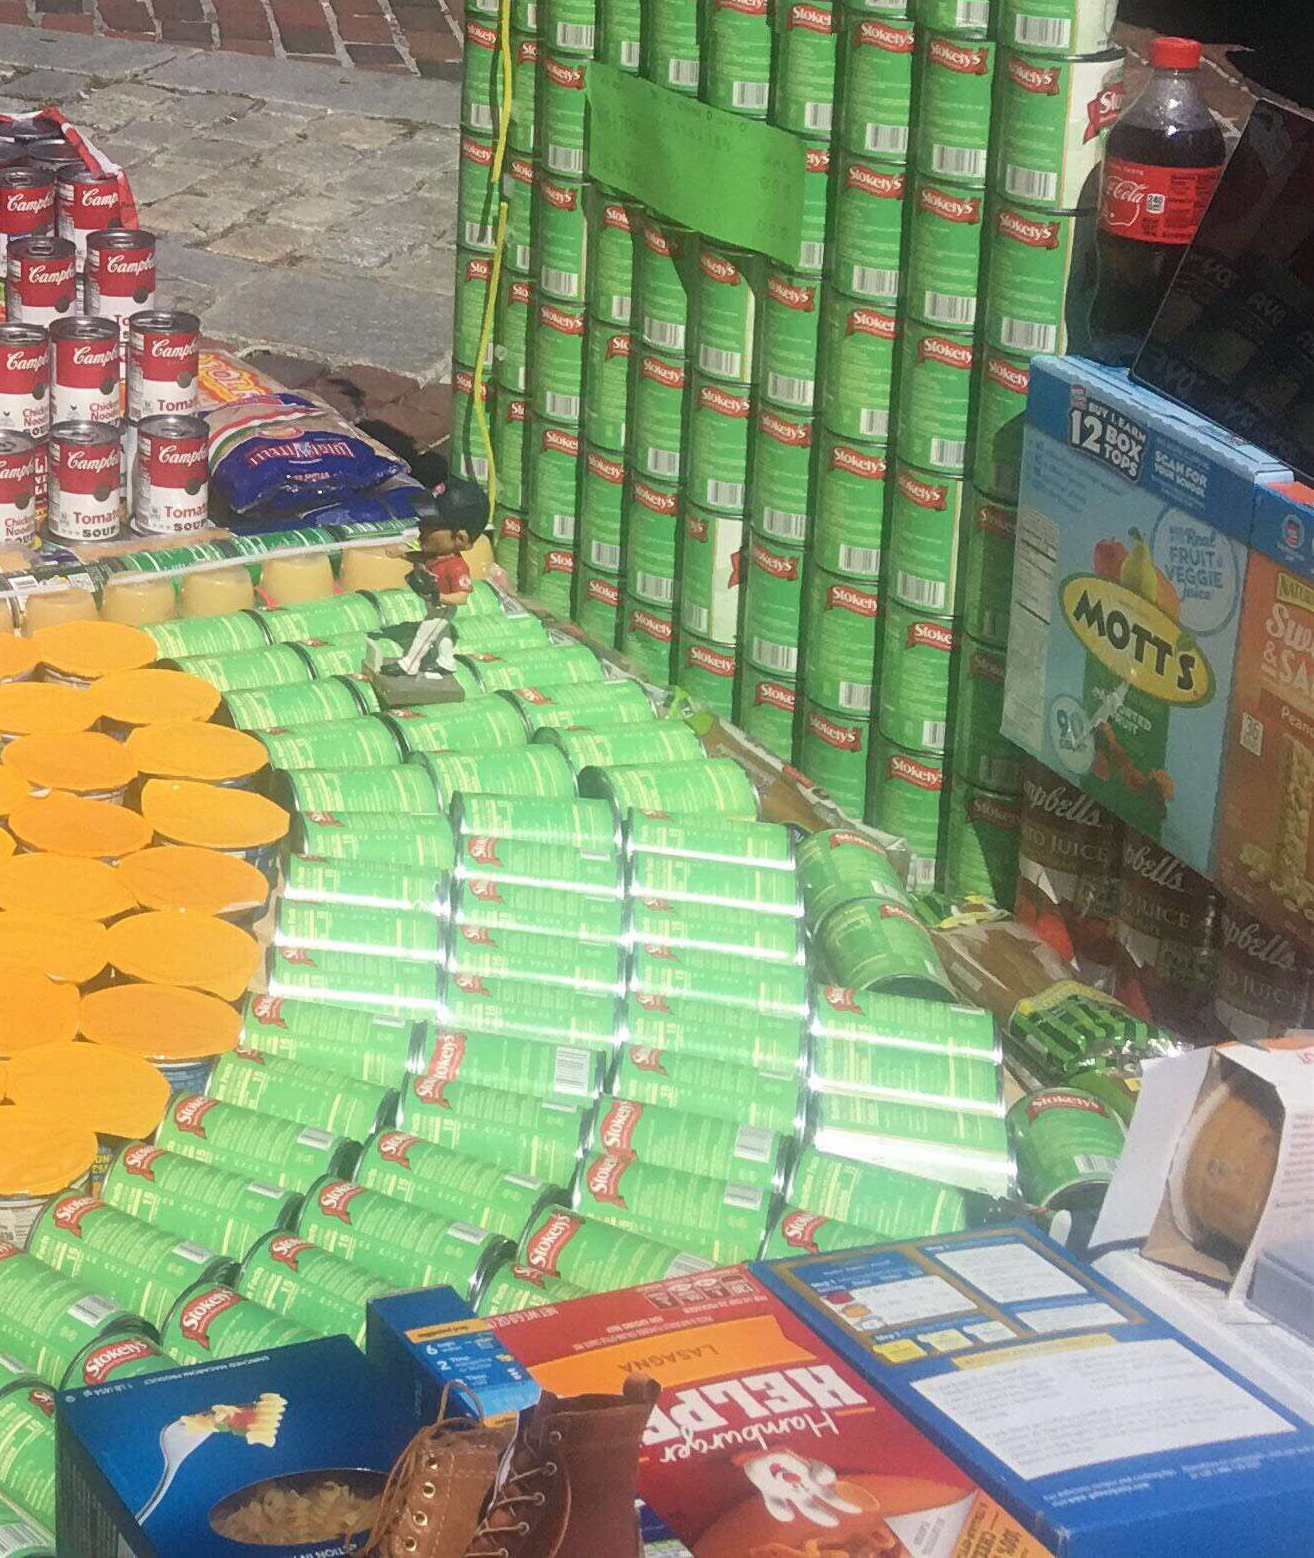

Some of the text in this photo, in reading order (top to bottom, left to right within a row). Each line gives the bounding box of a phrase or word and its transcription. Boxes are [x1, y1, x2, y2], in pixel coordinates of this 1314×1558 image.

[1071, 409, 1142, 462] 12 BOX
[1104, 443, 1138, 477] TOPS
[1154, 451, 1208, 487] SCAN FOR
[82, 527, 115, 538] SOUP
[1169, 545, 1215, 565] FRUIT
[619, 1343, 719, 1374] LASAGNA
[661, 1410, 839, 1464] Hamburger
